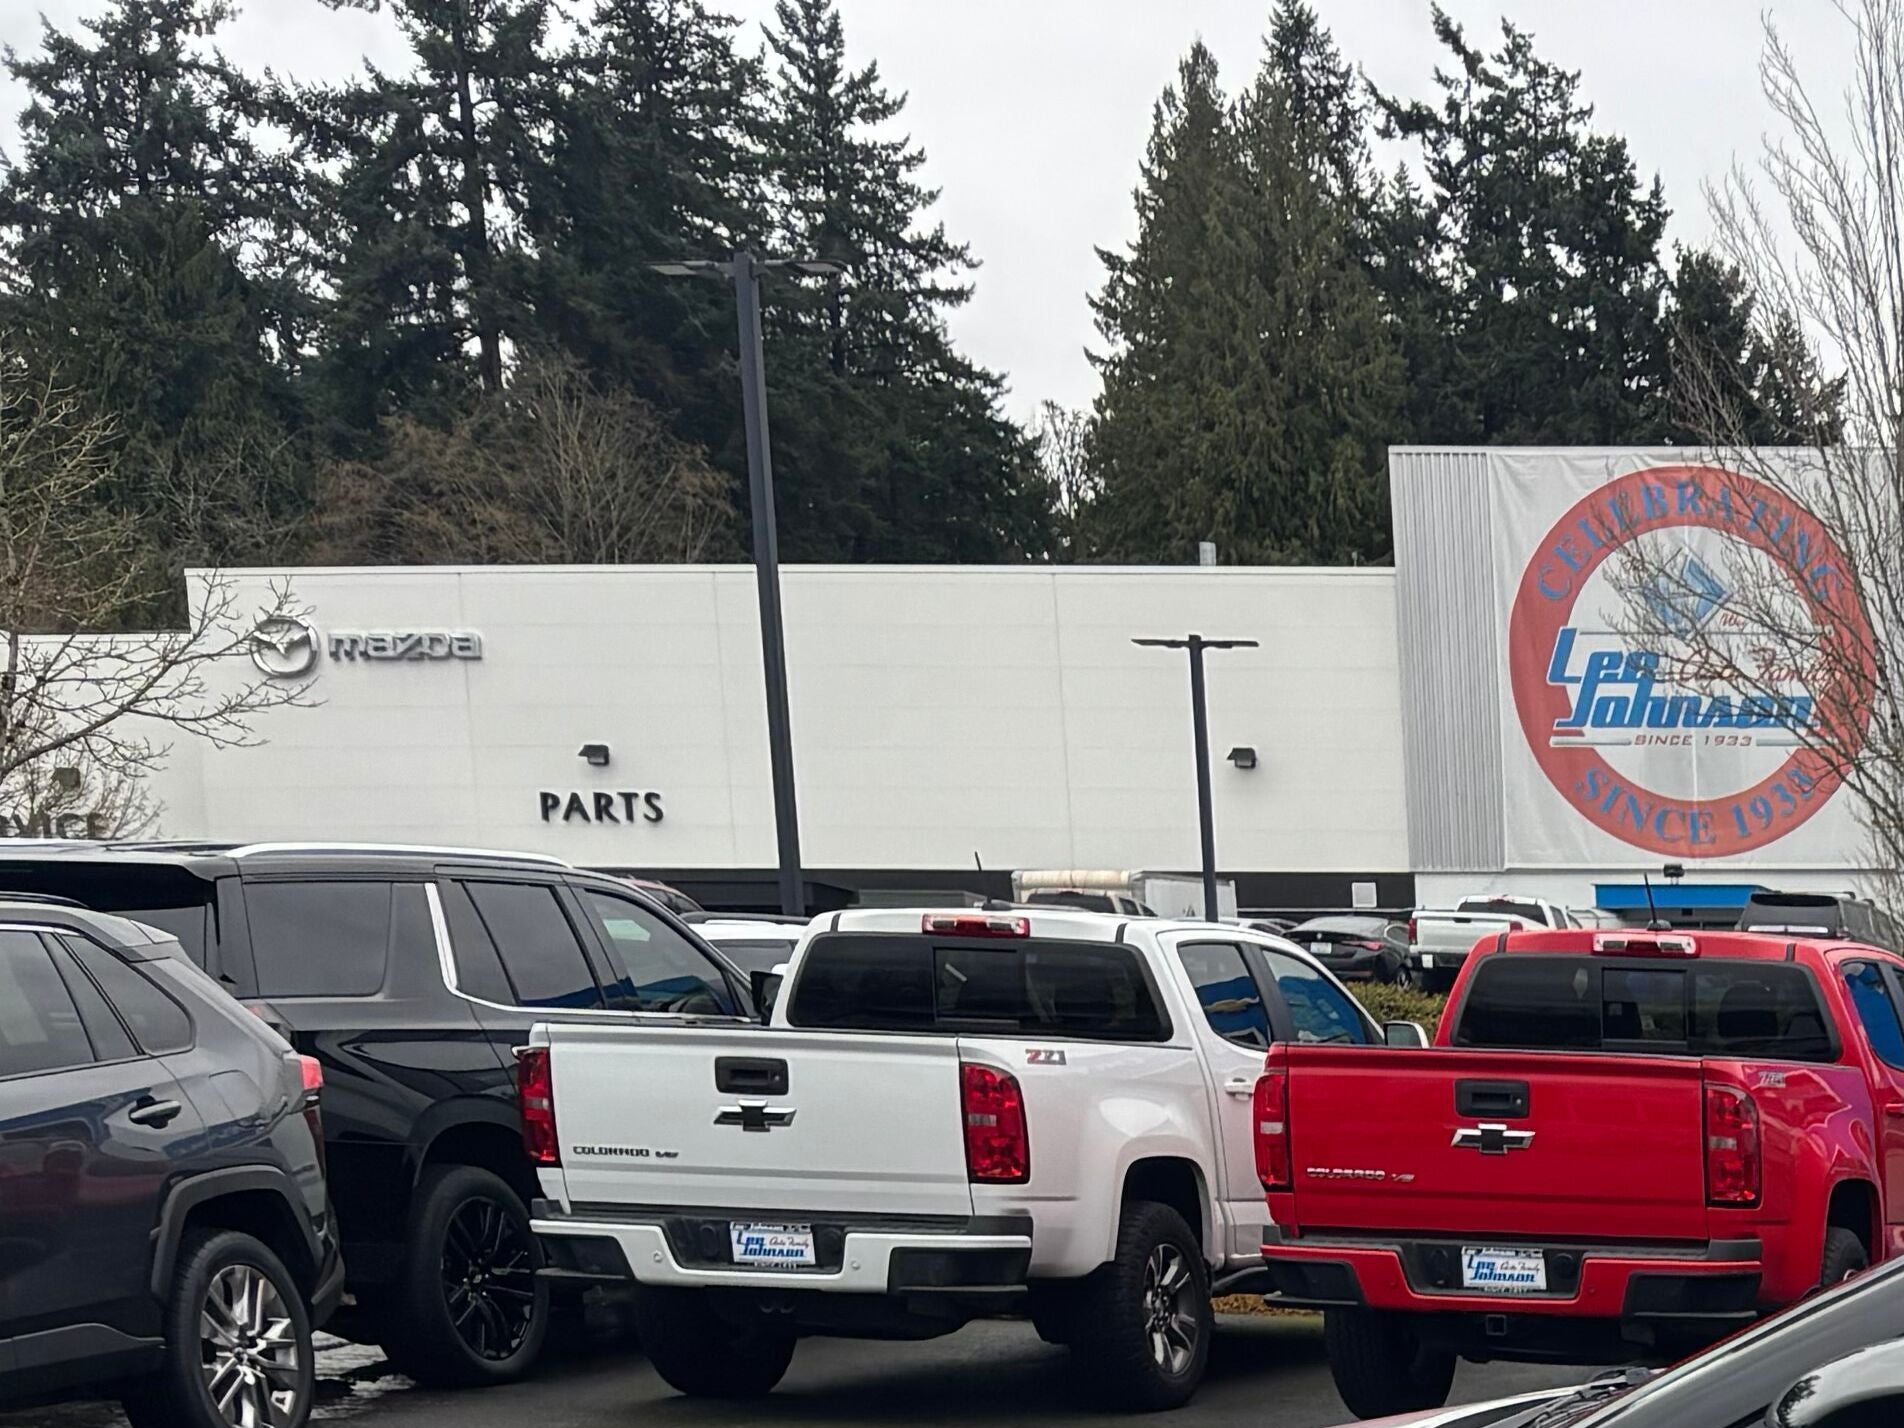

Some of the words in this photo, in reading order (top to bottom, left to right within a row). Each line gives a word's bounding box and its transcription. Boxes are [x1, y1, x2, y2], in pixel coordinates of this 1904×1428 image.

[1536, 479, 1845, 602] CELEBRATING
[327, 630, 484, 661] mazda
[1547, 626, 1660, 684] Lee
[1553, 649, 1822, 730] Johnson
[1633, 733, 1693, 747] SINCE
[1703, 733, 1753, 747] 1933
[539, 790, 665, 824] PARTS
[1575, 766, 1718, 846] SINCE
